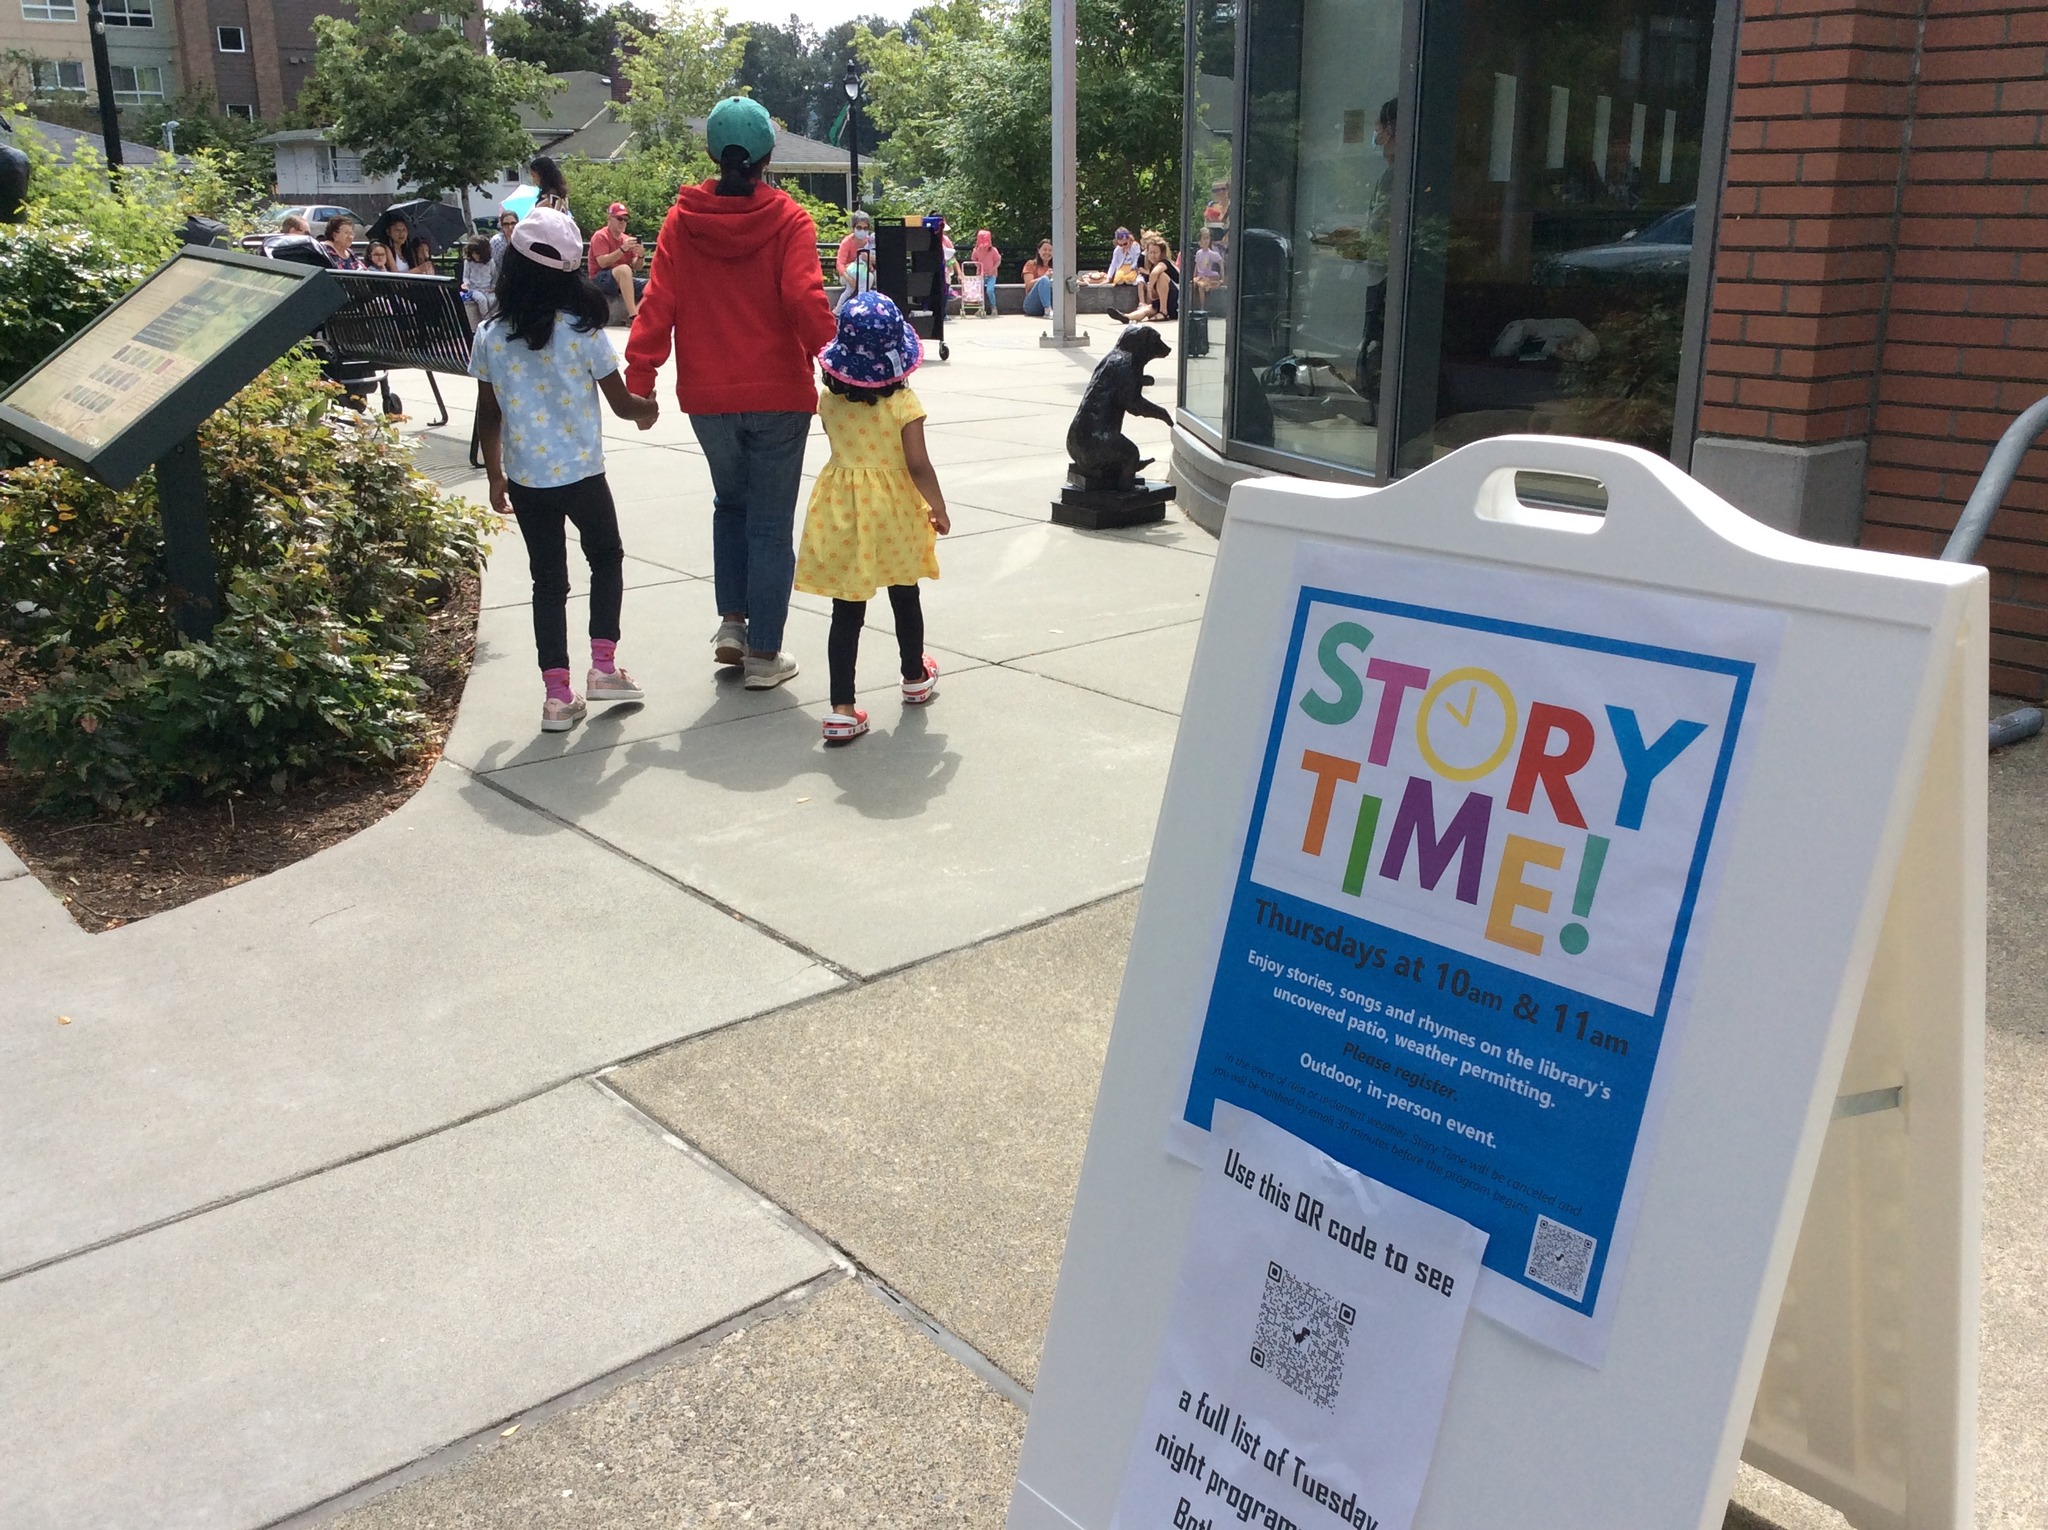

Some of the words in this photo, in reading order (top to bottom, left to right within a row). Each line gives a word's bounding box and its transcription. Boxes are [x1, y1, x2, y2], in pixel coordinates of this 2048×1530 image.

[1299, 621, 1709, 831] STORY
[1300, 749, 1610, 956] TIME!
[1248, 949, 1284, 978] Enjoy
[1286, 967, 1335, 996] stories,
[1339, 987, 1382, 1013] songs
[1385, 1004, 1415, 1025] and
[1417, 1014, 1476, 1048] rhymes
[1480, 1040, 1501, 1059] on
[1506, 1047, 1534, 1070] the
[1538, 1058, 1611, 1100] library's
[1256, 898, 1387, 969] Thursdays
[1394, 954, 1425, 982] at
[1437, 963, 1503, 1011] 10am
[1513, 994, 1540, 1024] &
[1554, 1003, 1629, 1056] 11am
[1273, 986, 1346, 1023] uncovered
[1347, 1014, 1389, 1043] patio,
[1395, 1033, 1458, 1067] weather
[1459, 1060, 1555, 1108] permitting.
[1212, 1065, 1229, 1078] you
[1231, 1073, 1246, 1086] will
[1248, 1079, 1259, 1091] be
[1261, 1087, 1294, 1107] notified
[1296, 1100, 1307, 1114] by
[1309, 1108, 1335, 1125] email
[1337, 1118, 1349, 1131] 30
[1350, 1127, 1390, 1150] minutes
[1391, 1143, 1424, 1166] before
[1426, 1159, 1443, 1175] the
[1443, 1170, 1490, 1196] program
[1235, 1056, 1249, 1070] the
[1251, 1064, 1274, 1080] event
[1276, 1075, 1287, 1087] of
[1288, 1081, 1306, 1095] rain
[1308, 1090, 1319, 1099] or
[1319, 1094, 1364, 1121] inclement
[1411, 1134, 1439, 1154] Story
[1441, 1146, 1467, 1165] Time
[1470, 1160, 1489, 1176] will
[1491, 1169, 1505, 1184] be
[1507, 1178, 1557, 1206] canceled
[1558, 1200, 1583, 1217] and
[1300, 1052, 1362, 1093] Outdoor,
[1367, 1080, 1442, 1125] in-person
[1446, 1117, 1496, 1149] event.
[1342, 1042, 1391, 1071] Please
[1393, 1066, 1457, 1102] register.
[1224, 1148, 1256, 1190] Use
[1258, 1173, 1291, 1212] this
[1294, 1191, 1324, 1231] QR
[1327, 1225, 1377, 1260] code
[1384, 1243, 1408, 1274] to
[1414, 1261, 1455, 1297] see
[1155, 1433, 1206, 1481] night
[1205, 1469, 1301, 1530] program
[1178, 1390, 1192, 1413] a
[1195, 1391, 1230, 1436] full
[1231, 1414, 1261, 1461] list
[1263, 1447, 1290, 1477] of
